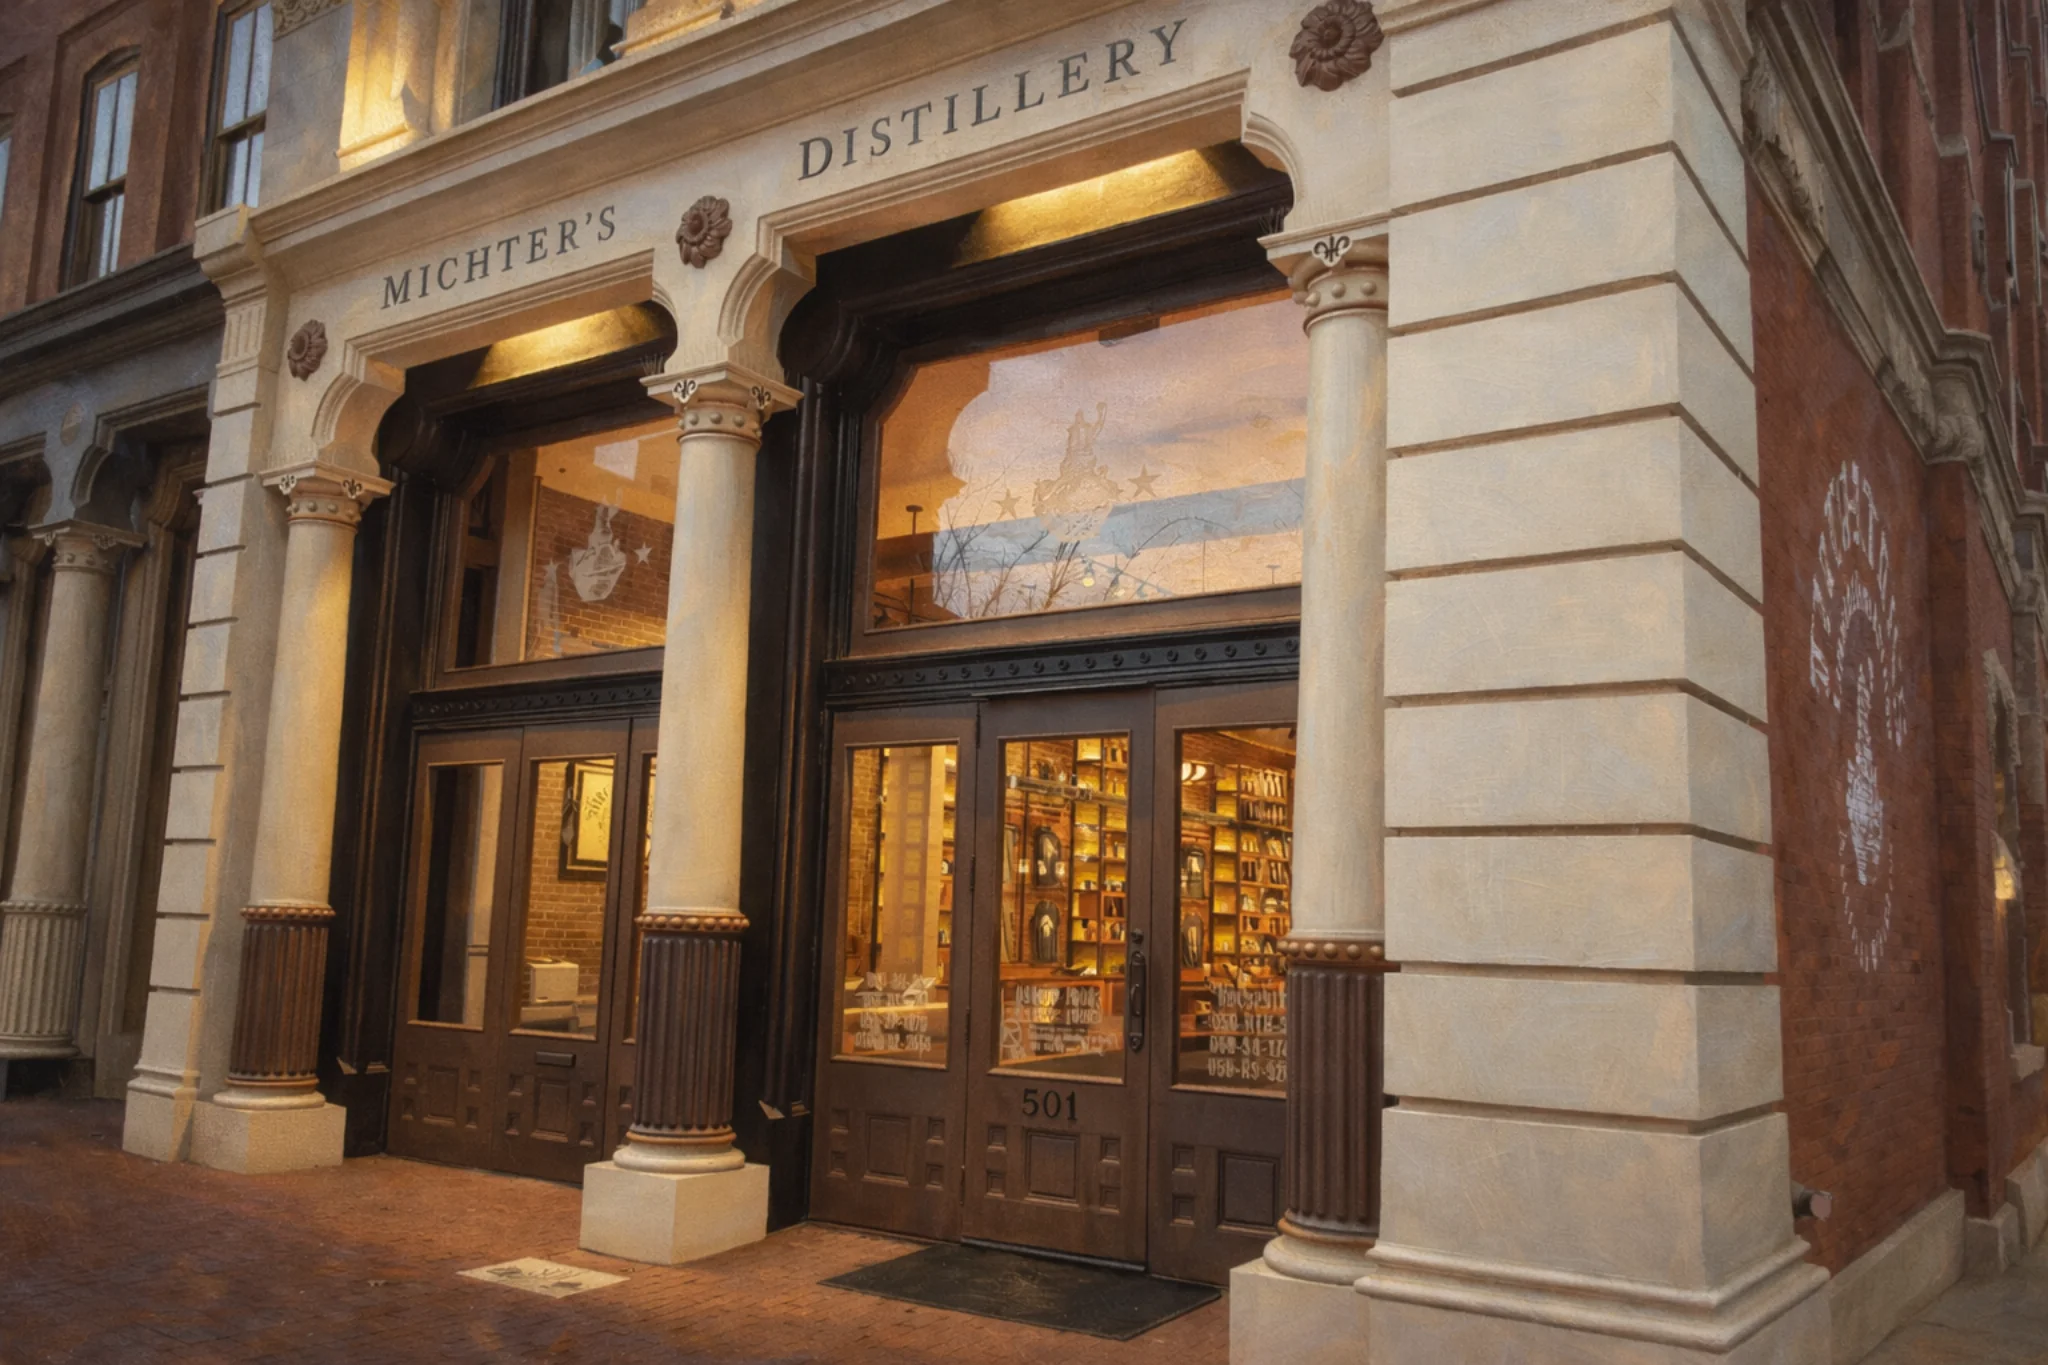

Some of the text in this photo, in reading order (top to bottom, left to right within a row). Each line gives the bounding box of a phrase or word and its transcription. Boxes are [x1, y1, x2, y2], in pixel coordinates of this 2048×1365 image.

[380, 18, 1188, 310] MICHTER'S DISTILLERY
[1022, 1088, 1078, 1122] 501
